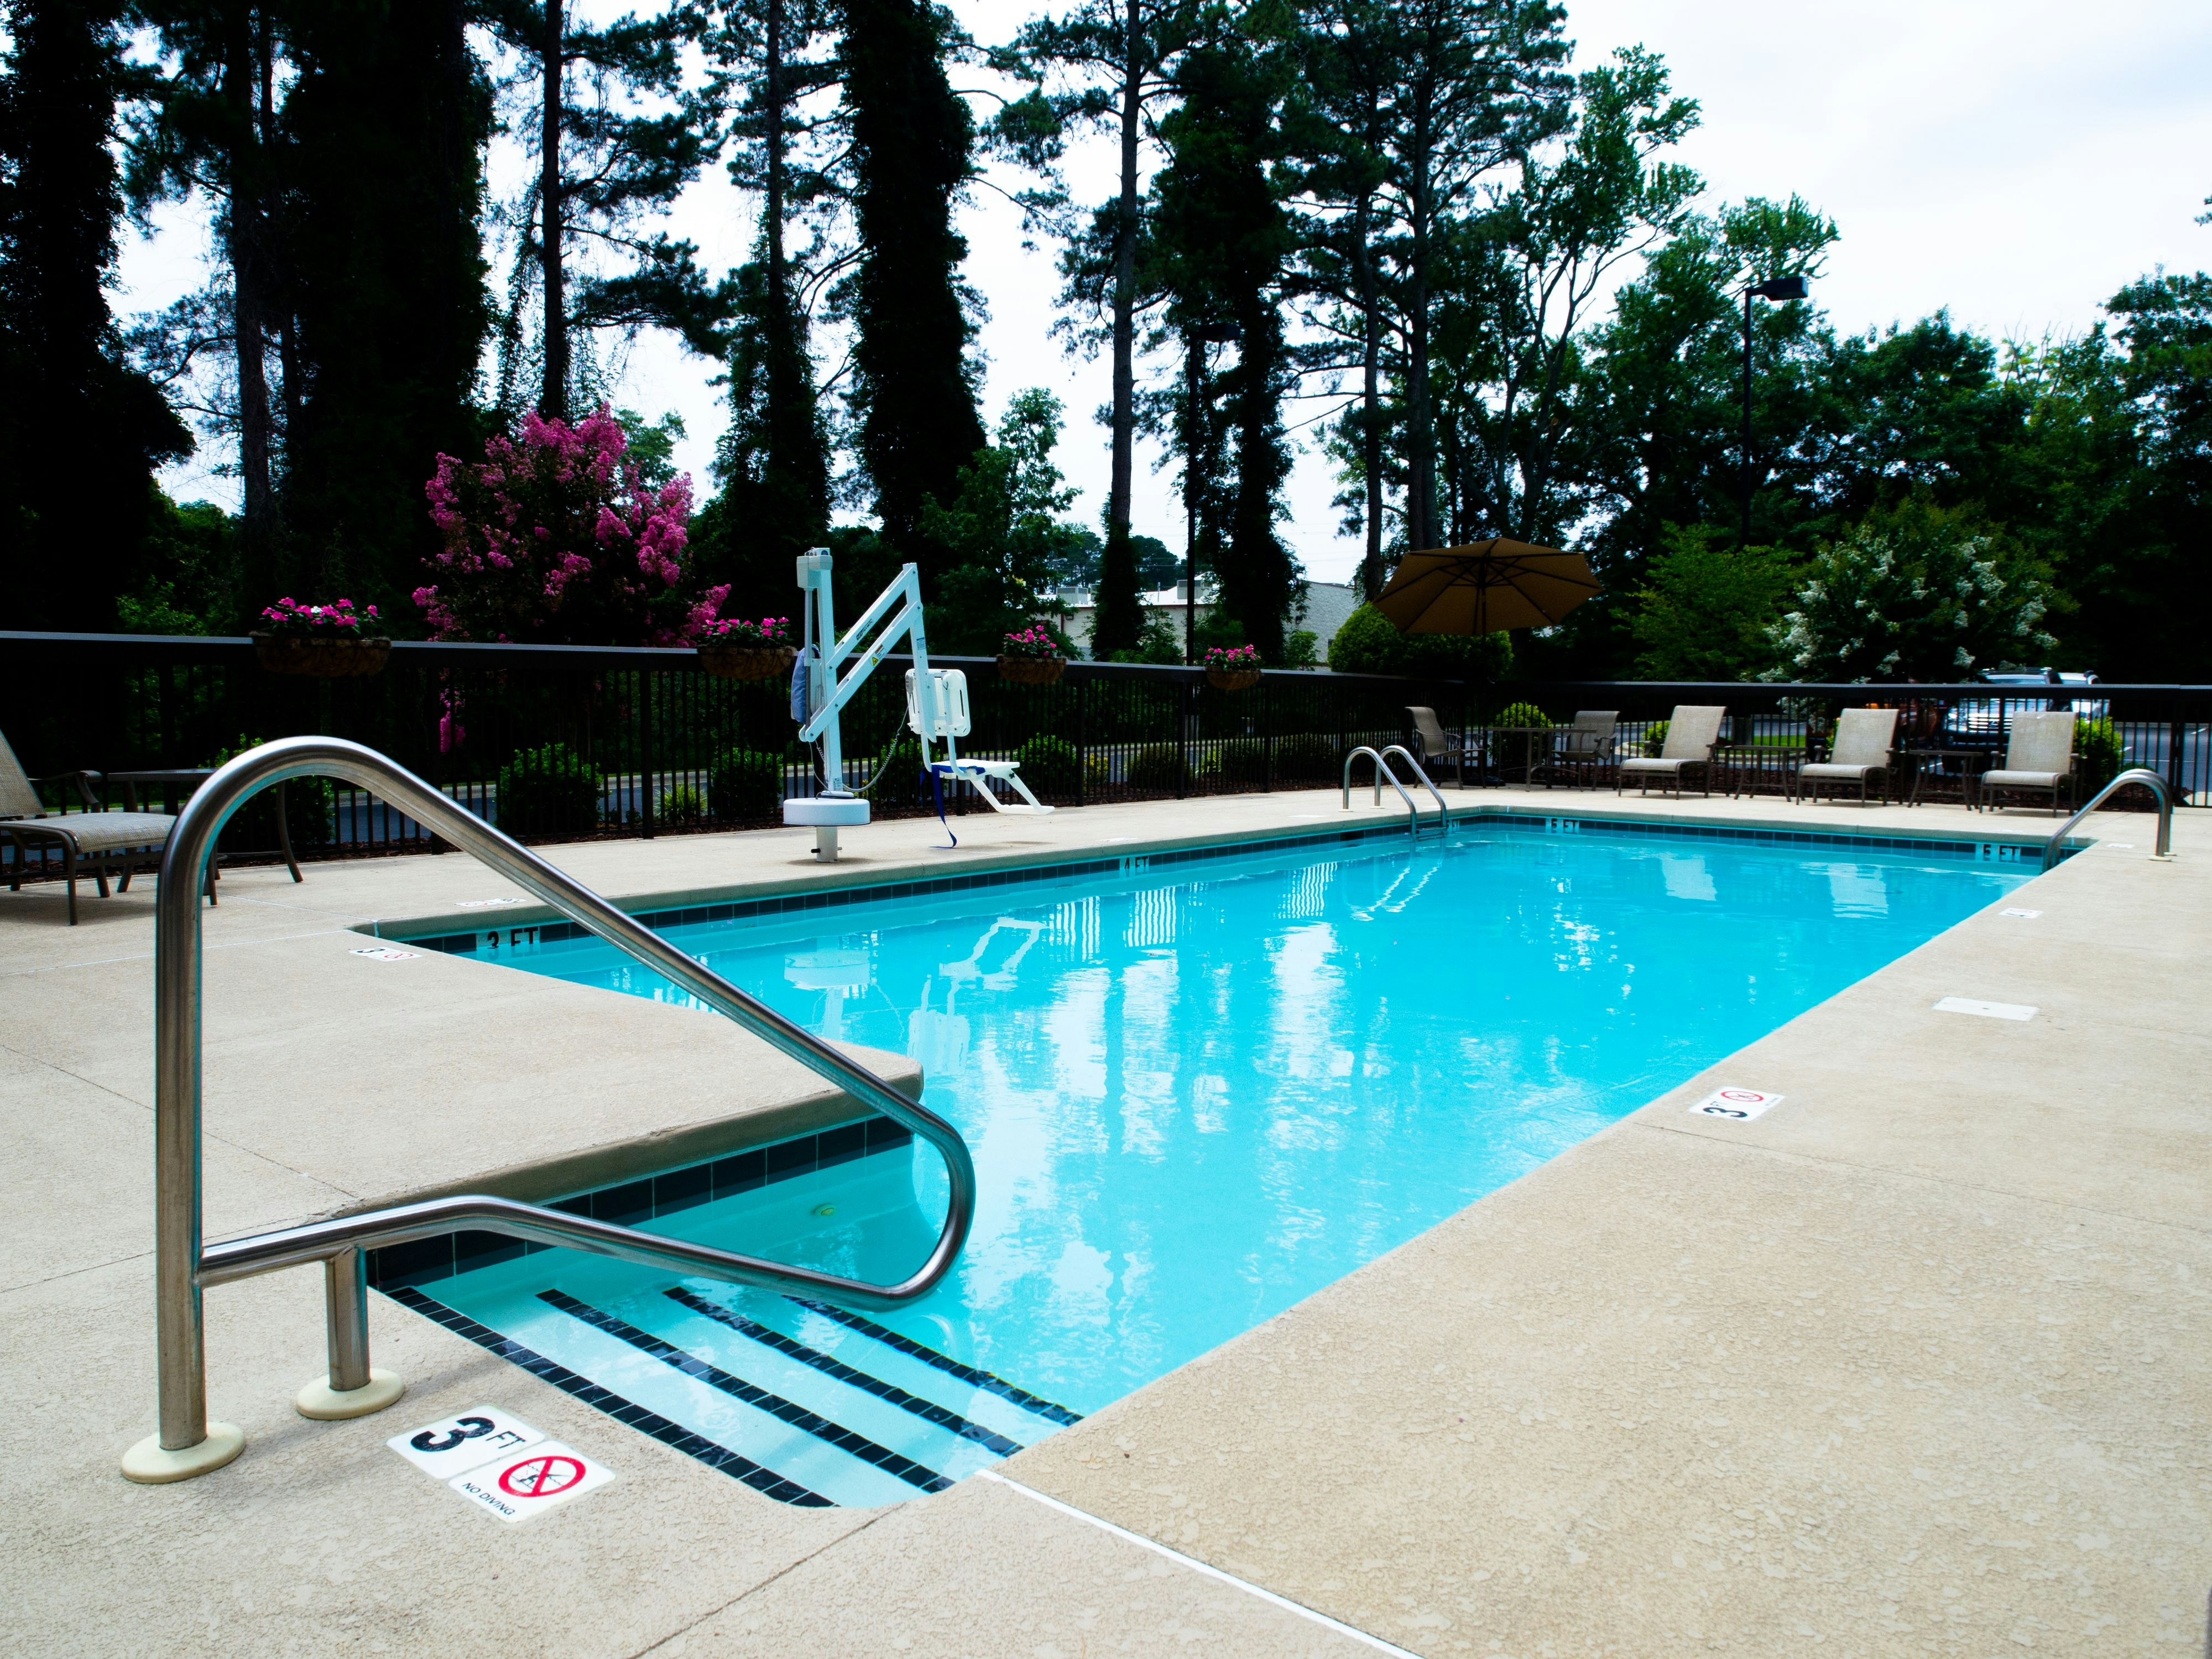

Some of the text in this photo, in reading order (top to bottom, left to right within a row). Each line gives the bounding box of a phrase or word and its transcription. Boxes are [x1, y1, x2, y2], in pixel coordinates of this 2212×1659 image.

[1563, 819, 1579, 828] FT
[1999, 845, 2019, 855] FT
[1135, 855, 1149, 868] FT
[487, 926, 539, 949] 3 FT
[1703, 1107, 1747, 1118] 3
[410, 1417, 527, 1452] 3 FT
[462, 1483, 515, 1515] NO DIVING
